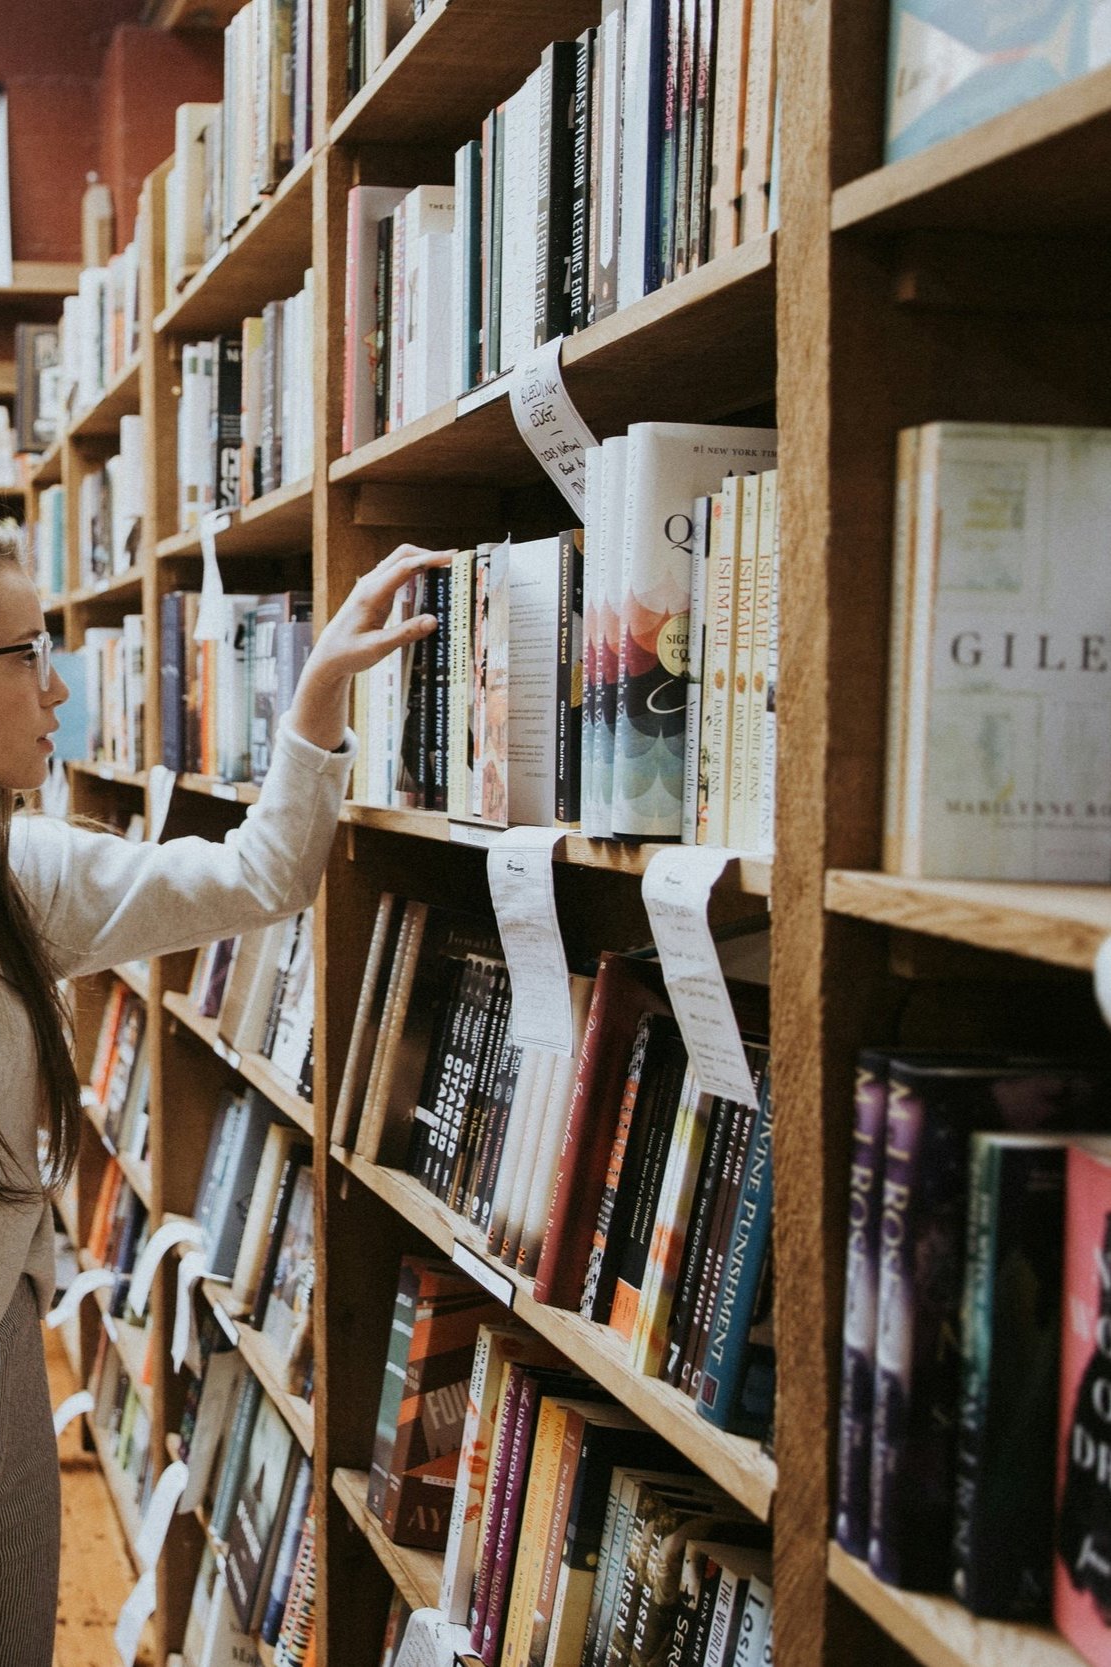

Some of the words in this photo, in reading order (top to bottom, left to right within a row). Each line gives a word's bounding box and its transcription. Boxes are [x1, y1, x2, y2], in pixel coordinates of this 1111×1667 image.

[539, 61, 551, 128] THOMAS
[575, 43, 588, 112] THOMAS
[537, 130, 551, 199] PYNCHON
[573, 116, 586, 189] PYNCHON
[536, 210, 547, 284] BLEEDING
[572, 198, 584, 275] BLEEDING
[534, 286, 546, 326] EDGE
[570, 277, 582, 318] EDGE
[530, 404, 556, 428] EDGE
[707, 446, 730, 456] NEW
[731, 447, 758, 457] YORK
[761, 448, 778, 457] TIM
[436, 578, 444, 608] LOVE
[561, 544, 569, 621] Monument
[715, 556, 731, 653] ISHMAEL
[755, 555, 771, 656] ISHMAEL
[736, 557, 752, 657] ISHMAEL
[436, 641, 444, 668] FAIL
[666, 633, 689, 646] SIG
[951, 631, 1109, 672] GILE
[435, 687, 443, 747] MATTHEW
[713, 700, 723, 747] DANIEL
[734, 704, 744, 754] DANIEL
[751, 703, 761, 754] DANIEL
[435, 749, 443, 786] QUICK
[710, 751, 721, 795] QUINN
[732, 756, 742, 802] QUINN
[748, 756, 759, 803] QUINN
[494, 997, 502, 1012] THE
[502, 1000, 510, 1017] THE
[478, 1015, 498, 1093] IMPERFECTIONISTS
[485, 1020, 506, 1097] IMPERFECTIONISTS
[581, 1012, 599, 1069] Devil
[573, 1067, 584, 1080] in
[437, 1058, 463, 1151] OTARED
[446, 1063, 472, 1158] OTARED
[560, 1081, 586, 1157] Jerusalem
[887, 1080, 912, 1120] M
[707, 1123, 725, 1169] RAKHA
[729, 1111, 741, 1138] WHY
[740, 1116, 751, 1143] WHY
[721, 1150, 733, 1180] CAME
[731, 1156, 743, 1186] CAME
[549, 1170, 564, 1213] NAOMI
[697, 1197, 707, 1214] the
[540, 1215, 557, 1260] RAGEN
[681, 1218, 703, 1303] CROCODILES
[710, 1199, 757, 1366] PUNISHMENT
[479, 1342, 488, 1364] AYN
[475, 1367, 484, 1399] RAND
[490, 1395, 512, 1488] UNRESTORED
[538, 1408, 551, 1440] KNOW
[551, 1422, 564, 1455] KNOW
[504, 1407, 526, 1501] UNRESTORED
[531, 1447, 544, 1479] YOUR
[544, 1463, 558, 1495] YOUR
[555, 1482, 567, 1510] RON
[483, 1493, 497, 1547] WOMAN
[524, 1483, 539, 1533] BEHOLDER
[535, 1499, 553, 1551] BEHOLDER
[549, 1513, 562, 1547] RASH
[494, 1507, 509, 1561] WOMAN
[630, 1517, 645, 1559] THE
[646, 1533, 662, 1578] THE
[488, 1567, 503, 1618] SHOBHA
[540, 1549, 558, 1602] READER
[718, 1580, 733, 1609] THE
[616, 1567, 636, 1632] RISEN
[633, 1584, 651, 1650] RISEN
[701, 1591, 711, 1620] RON
[666, 1616, 689, 1667] SERE
[693, 1625, 704, 1663] RASH
[708, 1611, 728, 1660] WORLD
[735, 1594, 765, 1667] Losi
